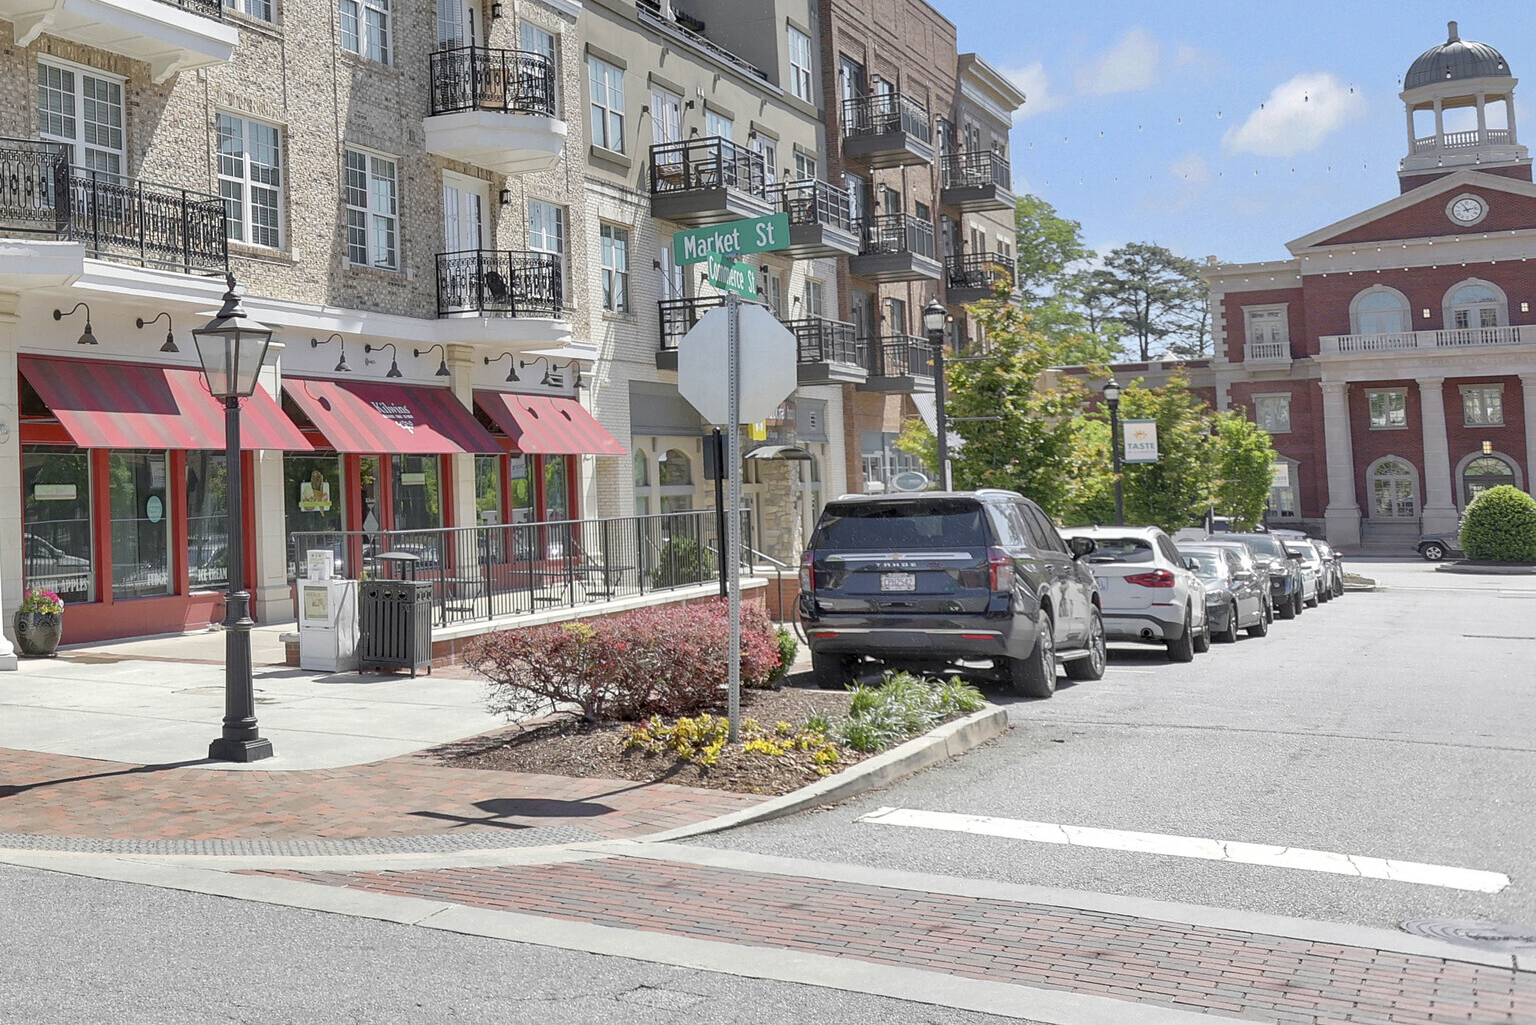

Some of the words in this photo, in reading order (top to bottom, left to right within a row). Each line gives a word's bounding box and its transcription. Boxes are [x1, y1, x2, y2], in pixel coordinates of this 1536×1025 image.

[684, 227, 741, 260] Market
[755, 221, 776, 247] St
[708, 255, 744, 291] Commerce
[747, 269, 756, 294] St
[1127, 442, 1156, 450] TASTE
